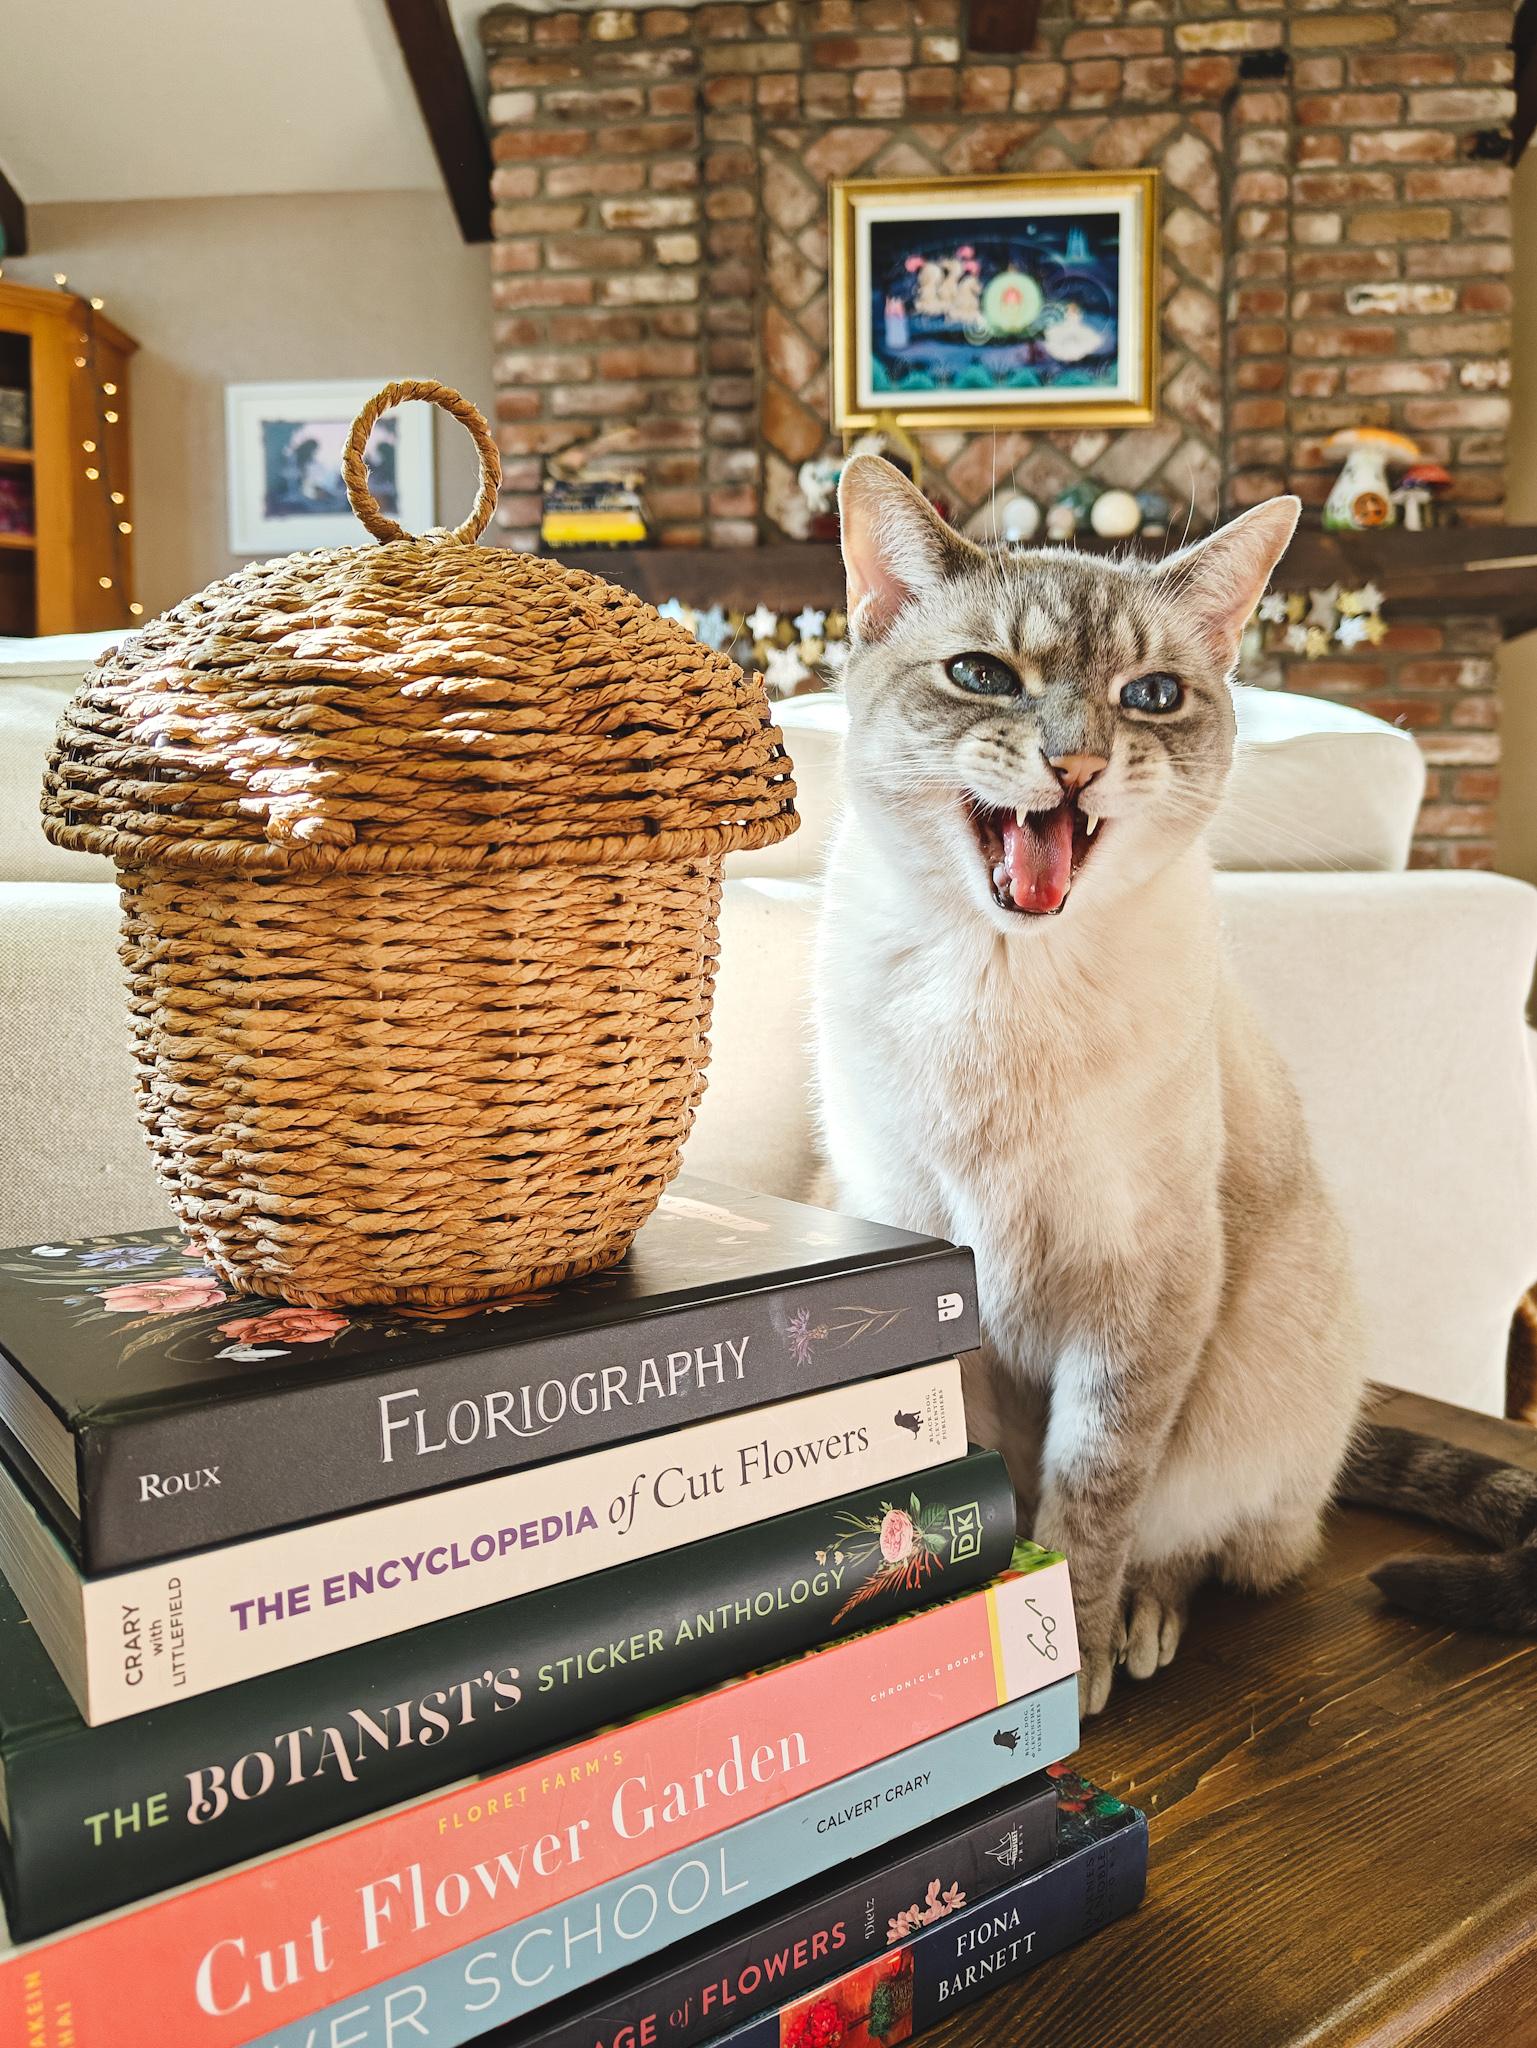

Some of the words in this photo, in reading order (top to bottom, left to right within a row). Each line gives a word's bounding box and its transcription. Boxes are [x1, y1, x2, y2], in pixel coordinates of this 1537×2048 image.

[378, 1336, 749, 1463] FLORIOGRAPHY
[230, 1584, 311, 1633] THE
[323, 1505, 598, 1606] ENCYCLOPEDIA
[608, 1473, 648, 1535] of
[653, 1462, 725, 1510] Cut
[736, 1426, 869, 1486] Flowers
[122, 1605, 142, 1686] CRARY
[150, 1618, 163, 1656] with
[168, 1577, 187, 1687] LITTLEFIELD
[84, 1791, 169, 1846] THE
[184, 1668, 522, 1825] BOTANIST'S
[537, 1628, 664, 1691] STICKER
[675, 1566, 846, 1646] ANTHOLOGY
[870, 1668, 941, 1702] CHRONICLE
[947, 1650, 984, 1671] BOOKS
[437, 1788, 528, 1835] FLORET
[541, 1750, 623, 1792] FARM'S
[815, 1794, 881, 1834] CALVERT
[884, 1771, 931, 1812] CRARY
[194, 1914, 334, 2017] Cut
[355, 1818, 590, 1953] Flower
[611, 1730, 810, 1840] Garden
[464, 1847, 750, 2012] SCHOOL
[864, 1898, 875, 1940] Dietz
[955, 1907, 1023, 1957] FIONA
[669, 1997, 693, 2027] of
[702, 1921, 847, 2016] FLOWERS
[937, 1930, 1037, 2003] BARNETT
